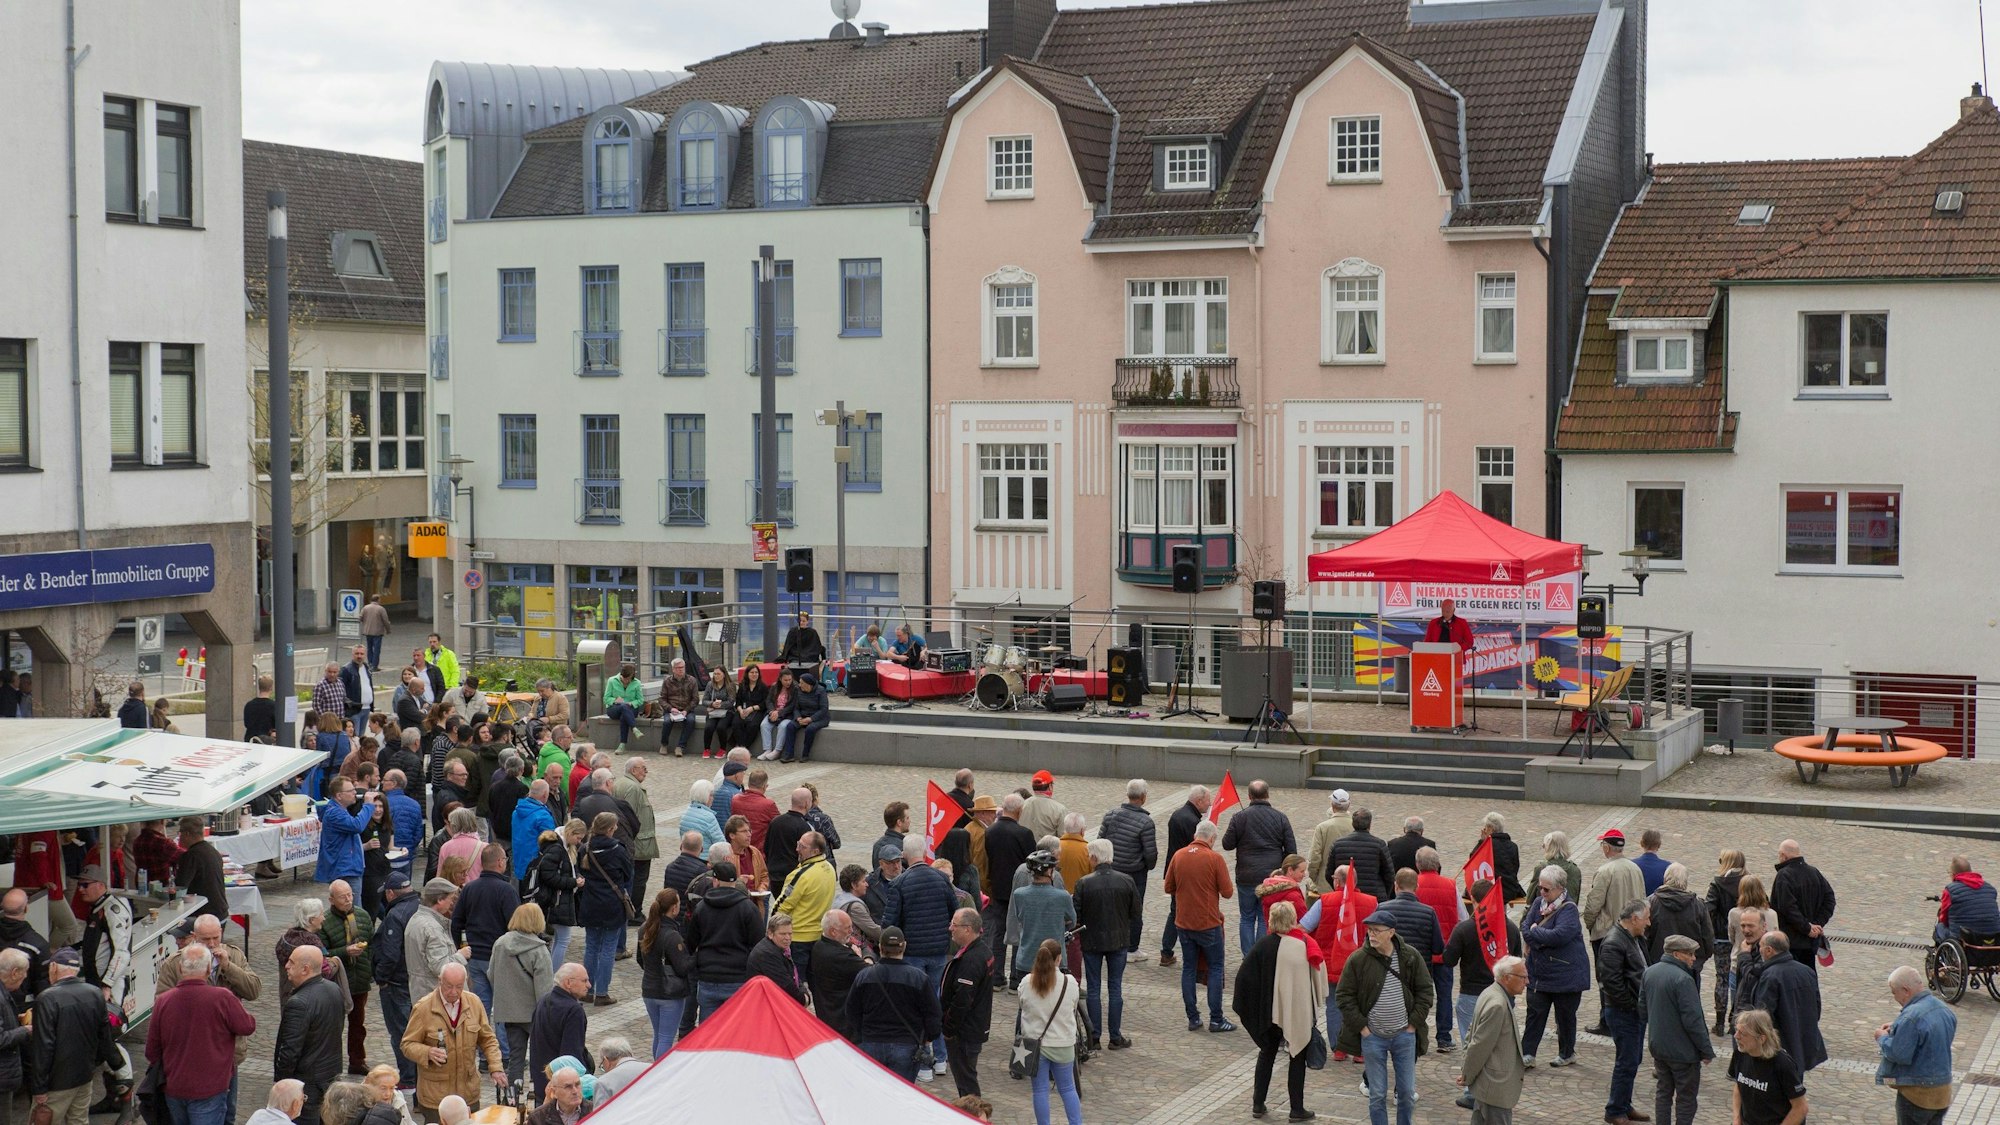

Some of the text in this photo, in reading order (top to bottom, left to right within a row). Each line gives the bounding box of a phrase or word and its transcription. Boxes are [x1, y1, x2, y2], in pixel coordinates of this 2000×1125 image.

[416, 526, 446, 537] ADAC
[23, 572, 37, 591] &
[40, 569, 88, 589] Bender
[91, 564, 163, 586] Immobilien
[165, 563, 209, 582] Gruppe
[1416, 586, 1468, 598] NIEMALS
[1416, 598, 1434, 608] FÜR
[1436, 600, 1467, 609] IER
[1469, 600, 1499, 609] GEGEN
[1737, 1071, 1769, 1092] Respekt!
